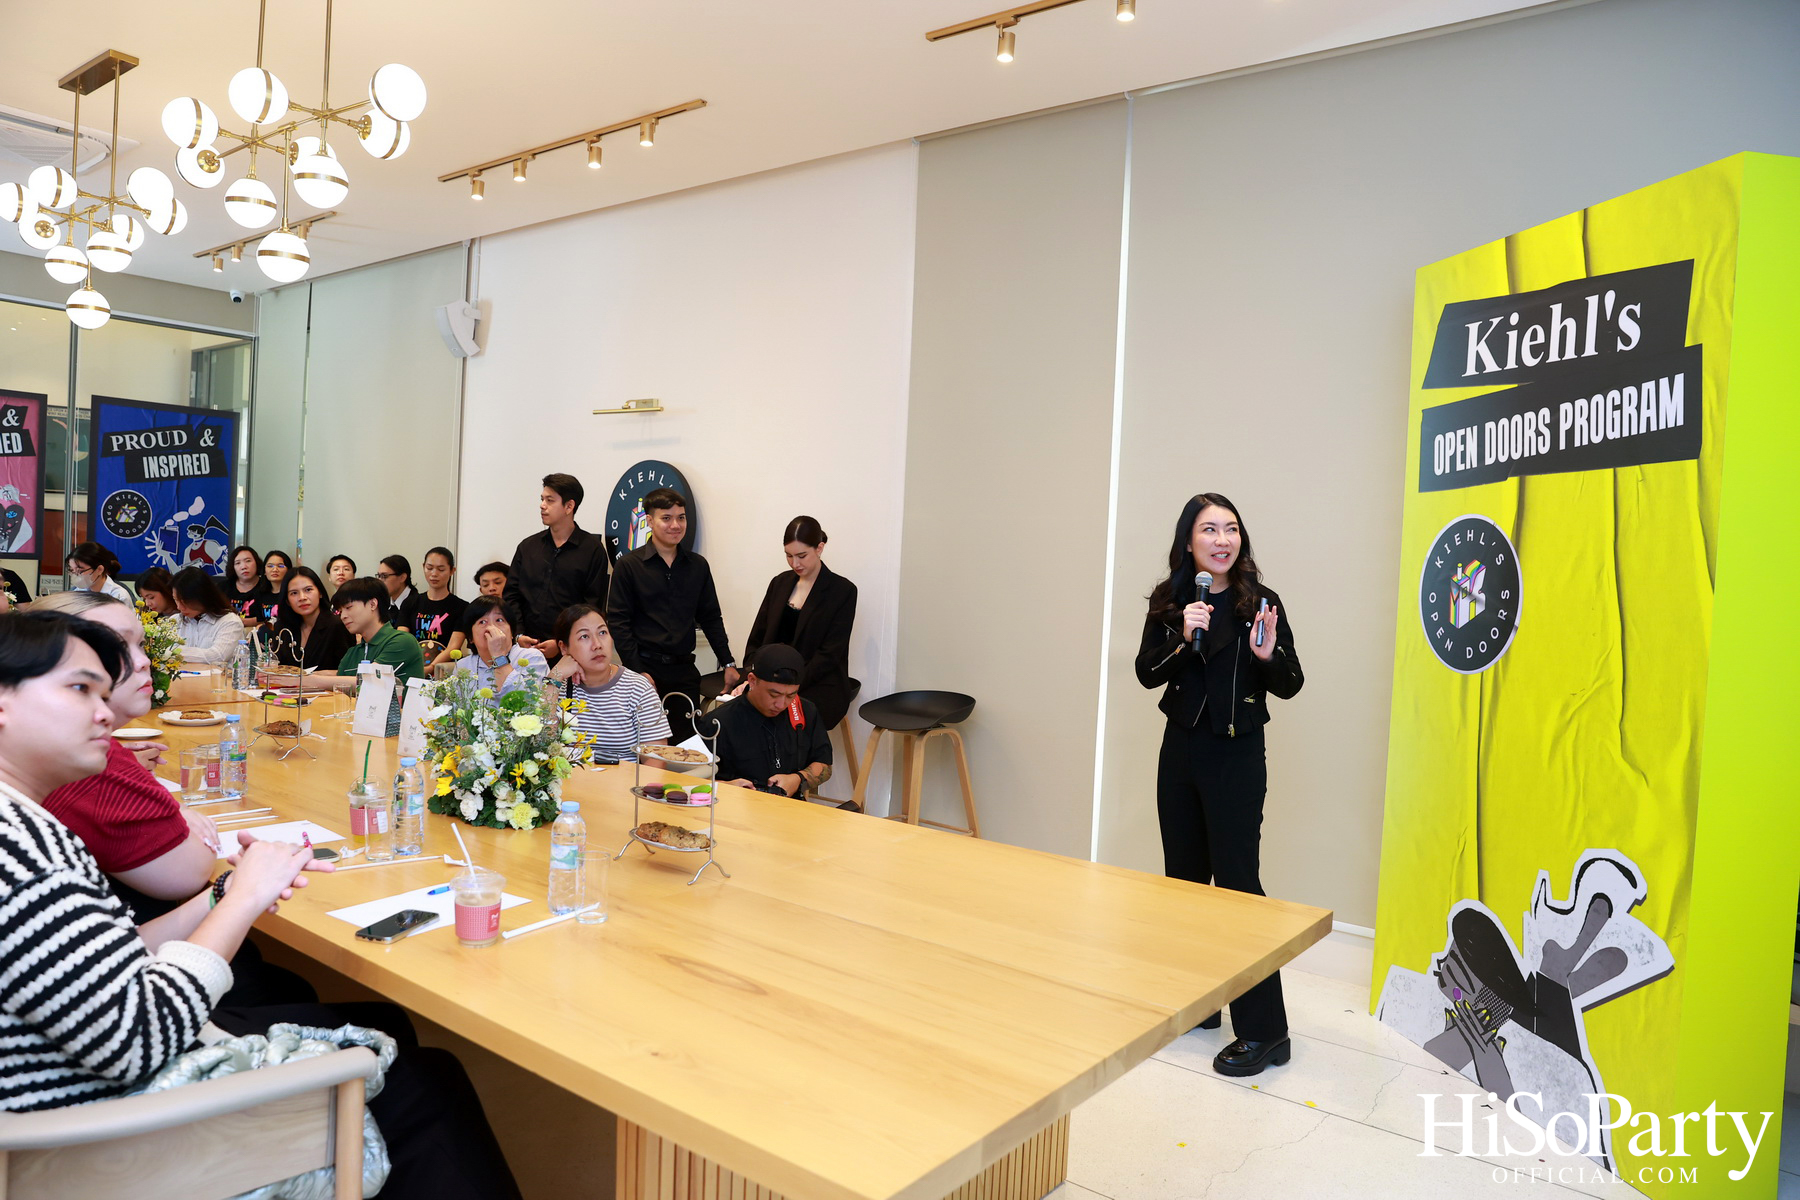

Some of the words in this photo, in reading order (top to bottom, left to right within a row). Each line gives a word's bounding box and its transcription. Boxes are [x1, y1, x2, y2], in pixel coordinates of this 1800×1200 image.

[1461, 289, 1642, 378] Kiehl's
[2, 408, 20, 427] &
[1433, 425, 1478, 476] OPEN
[1484, 407, 1551, 466] DOORS
[1559, 372, 1685, 451] PROGRAM
[109, 429, 188, 452] PROUD
[199, 428, 216, 447] &
[142, 452, 211, 479] INSPIRED
[619, 470, 673, 501] KIEHL'
[611, 519, 623, 560] OPE
[1435, 529, 1505, 569] KIEHL'S
[1428, 592, 1454, 652] OPEN
[1466, 589, 1510, 659] DOORS
